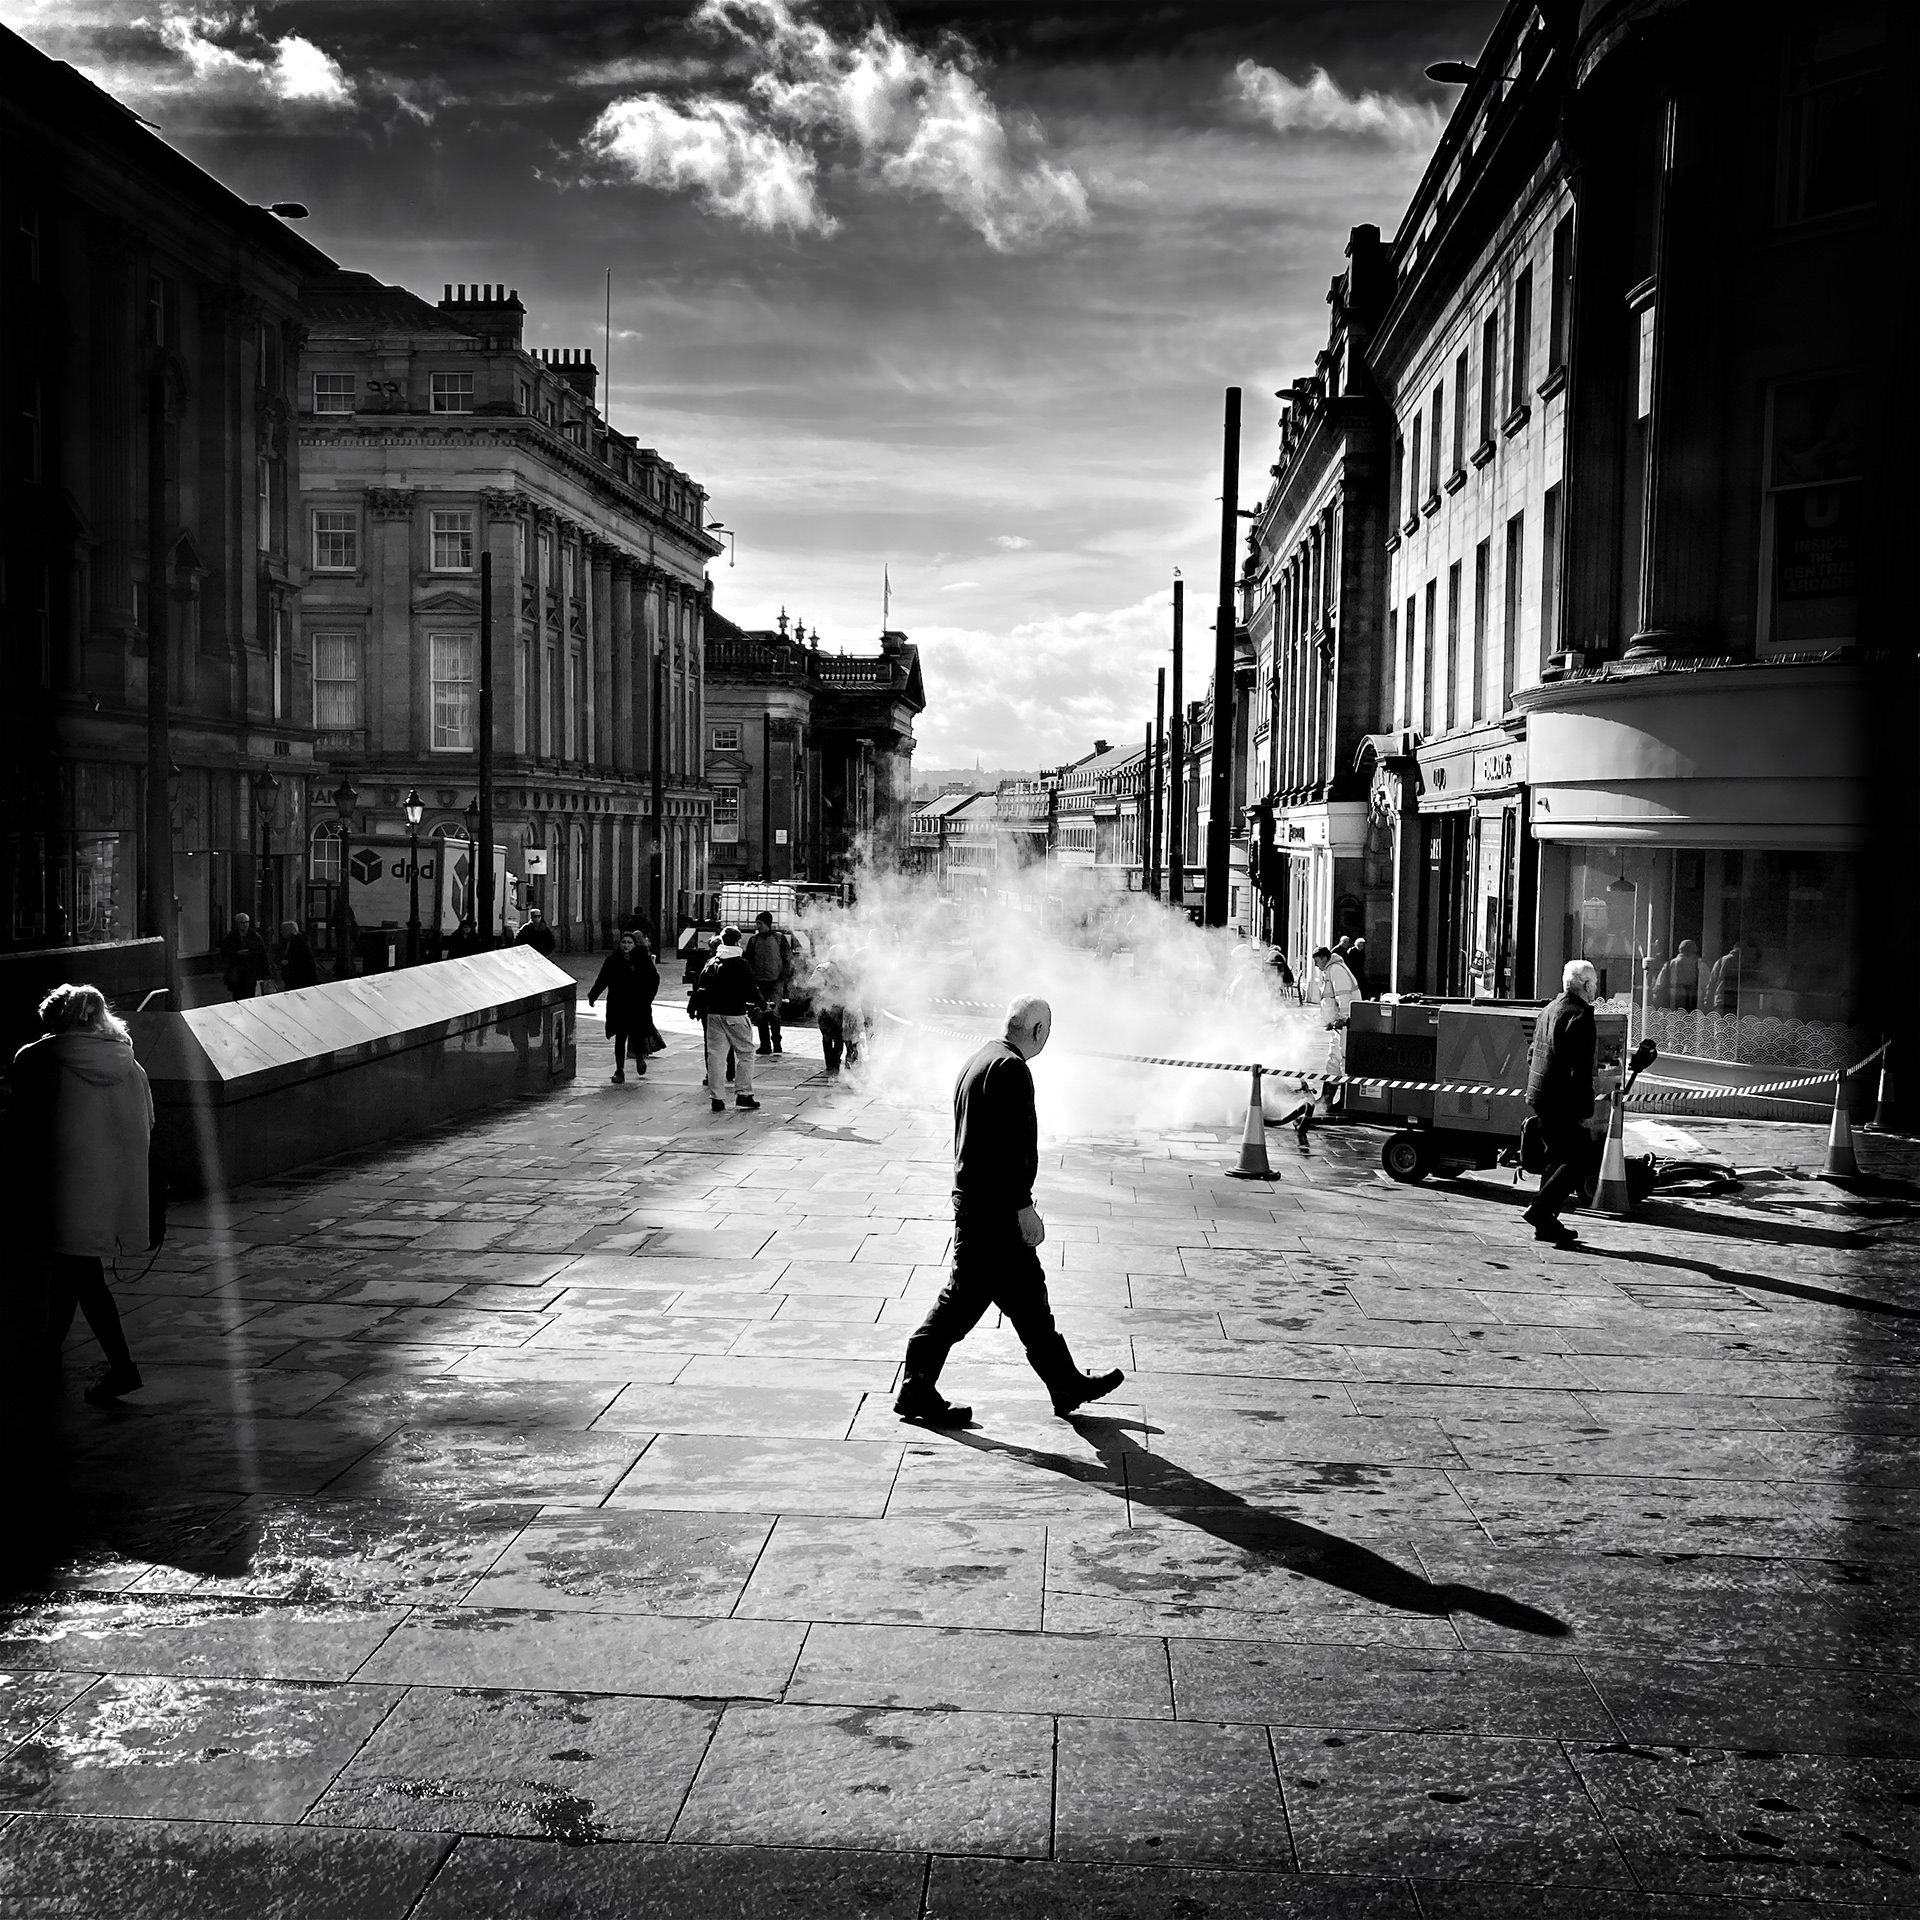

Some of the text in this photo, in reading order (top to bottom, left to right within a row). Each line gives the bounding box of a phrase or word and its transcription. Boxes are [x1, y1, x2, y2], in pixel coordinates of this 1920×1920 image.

[1793, 536, 1848, 554] INSIDE
[1810, 552, 1833, 564] THE
[1783, 560, 1857, 581] CENTRAL
[1786, 574, 1854, 594] ARCADE
[391, 857, 434, 883] dpd
